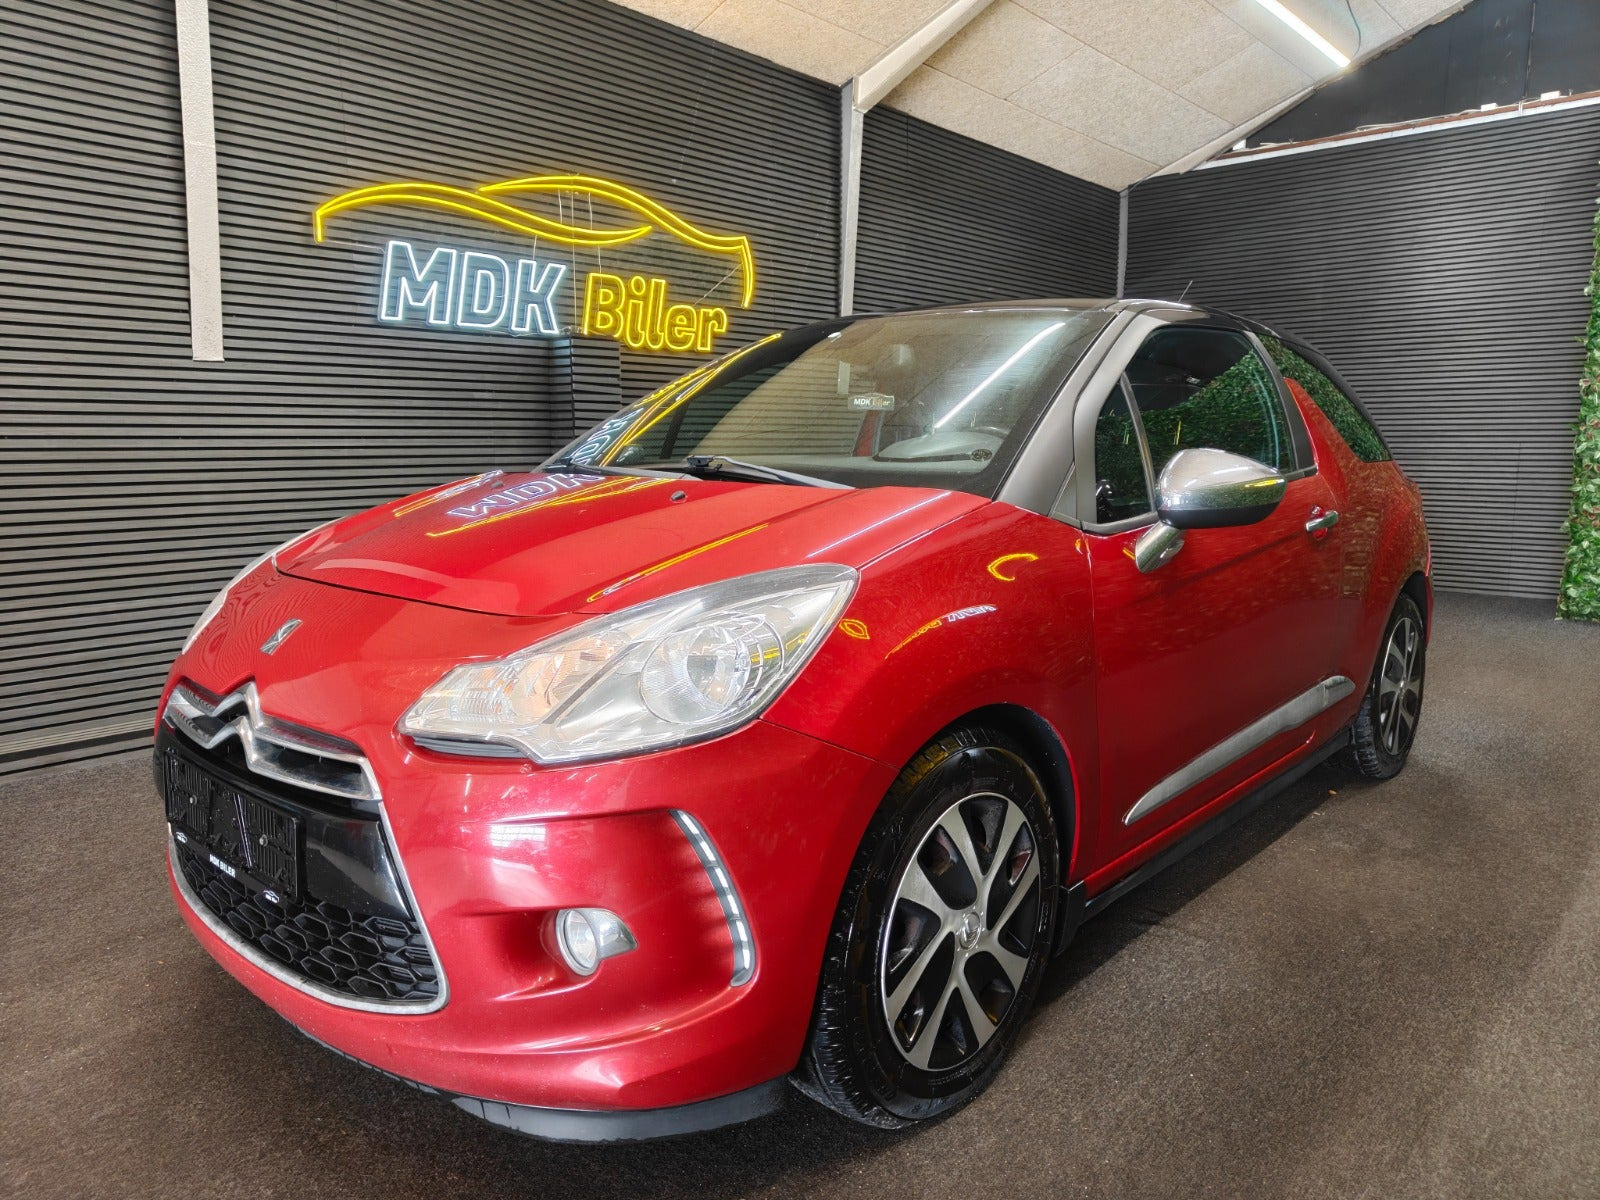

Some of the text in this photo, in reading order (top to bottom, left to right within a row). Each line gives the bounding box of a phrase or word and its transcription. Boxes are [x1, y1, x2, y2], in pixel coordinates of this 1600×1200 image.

[378, 239, 728, 353] MDK Biler
[853, 398, 871, 407] MDK
